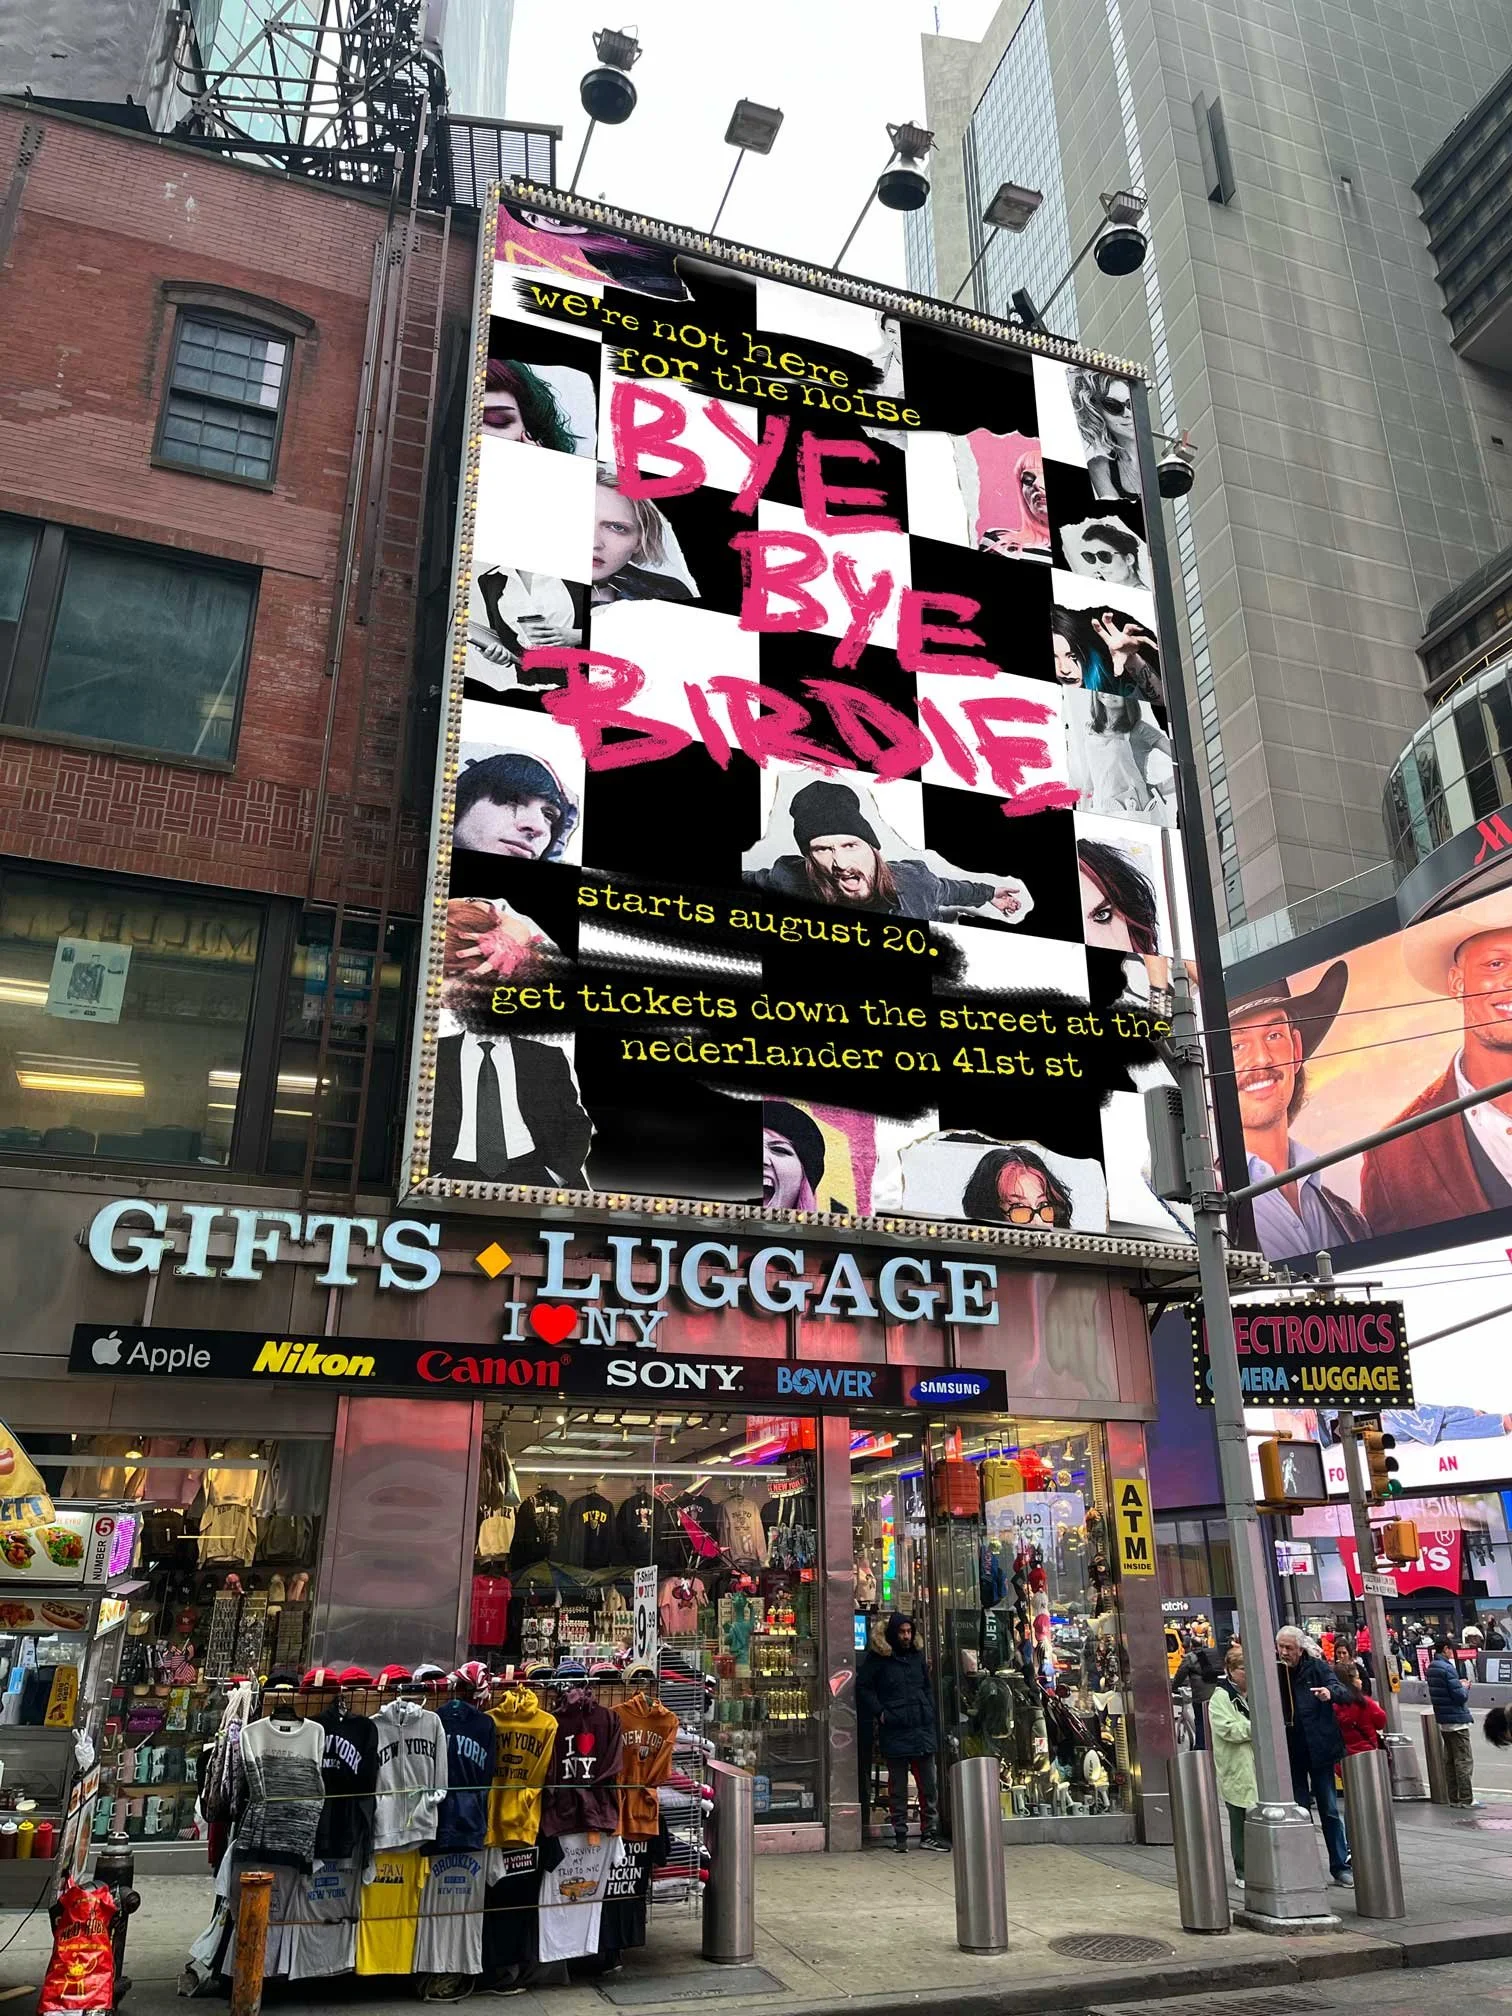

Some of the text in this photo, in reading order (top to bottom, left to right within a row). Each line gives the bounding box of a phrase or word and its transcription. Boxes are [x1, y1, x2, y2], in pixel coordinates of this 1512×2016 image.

[531, 286, 849, 388] we're not here
[617, 348, 922, 426] for the noise
[611, 381, 905, 538] BYE
[728, 530, 1002, 680] BYE
[518, 645, 1092, 818] BIRDIE
[577, 884, 940, 957] starts august 20.
[492, 983, 1173, 1040] get tickets down the street at the
[621, 1036, 1084, 1078] nederlander on 41st st
[88, 1199, 1000, 1326] GIFTS LUGGAGE
[502, 1301, 669, 1349] I NY
[1202, 1313, 1397, 1355] ECTRONICS
[126, 1341, 212, 1373] Apple
[252, 1340, 376, 1377] Nikon
[417, 1350, 561, 1387] Canon
[606, 1359, 744, 1391] SONY
[776, 1366, 876, 1398] BOWER
[919, 1379, 981, 1397] SAMSUNG
[1205, 1366, 1401, 1392] CMERA LUGGAGE
[1121, 1484, 1147, 1560] ATM
[92, 1540, 108, 1581] NUMBER
[1123, 1562, 1152, 1570] INSIDE
[1161, 1601, 1184, 1611] atch
[335, 1735, 362, 1775] YORK
[378, 1741, 400, 1767] NEW
[456, 1734, 487, 1771] YORK
[515, 1732, 545, 1759] YORK
[564, 1734, 576, 1757] I
[621, 1729, 663, 1750] NEW YOR
[561, 1757, 597, 1780] NY
[572, 1856, 584, 1866] MY
[628, 1841, 649, 1855] YOU
[432, 1854, 481, 1878] BROOKLYN
[558, 1863, 601, 1877] TRIP TO NYC
[607, 1867, 642, 1882] UCKIN
[327, 1888, 348, 1899] YORK
[606, 1880, 637, 1896] FUCK
